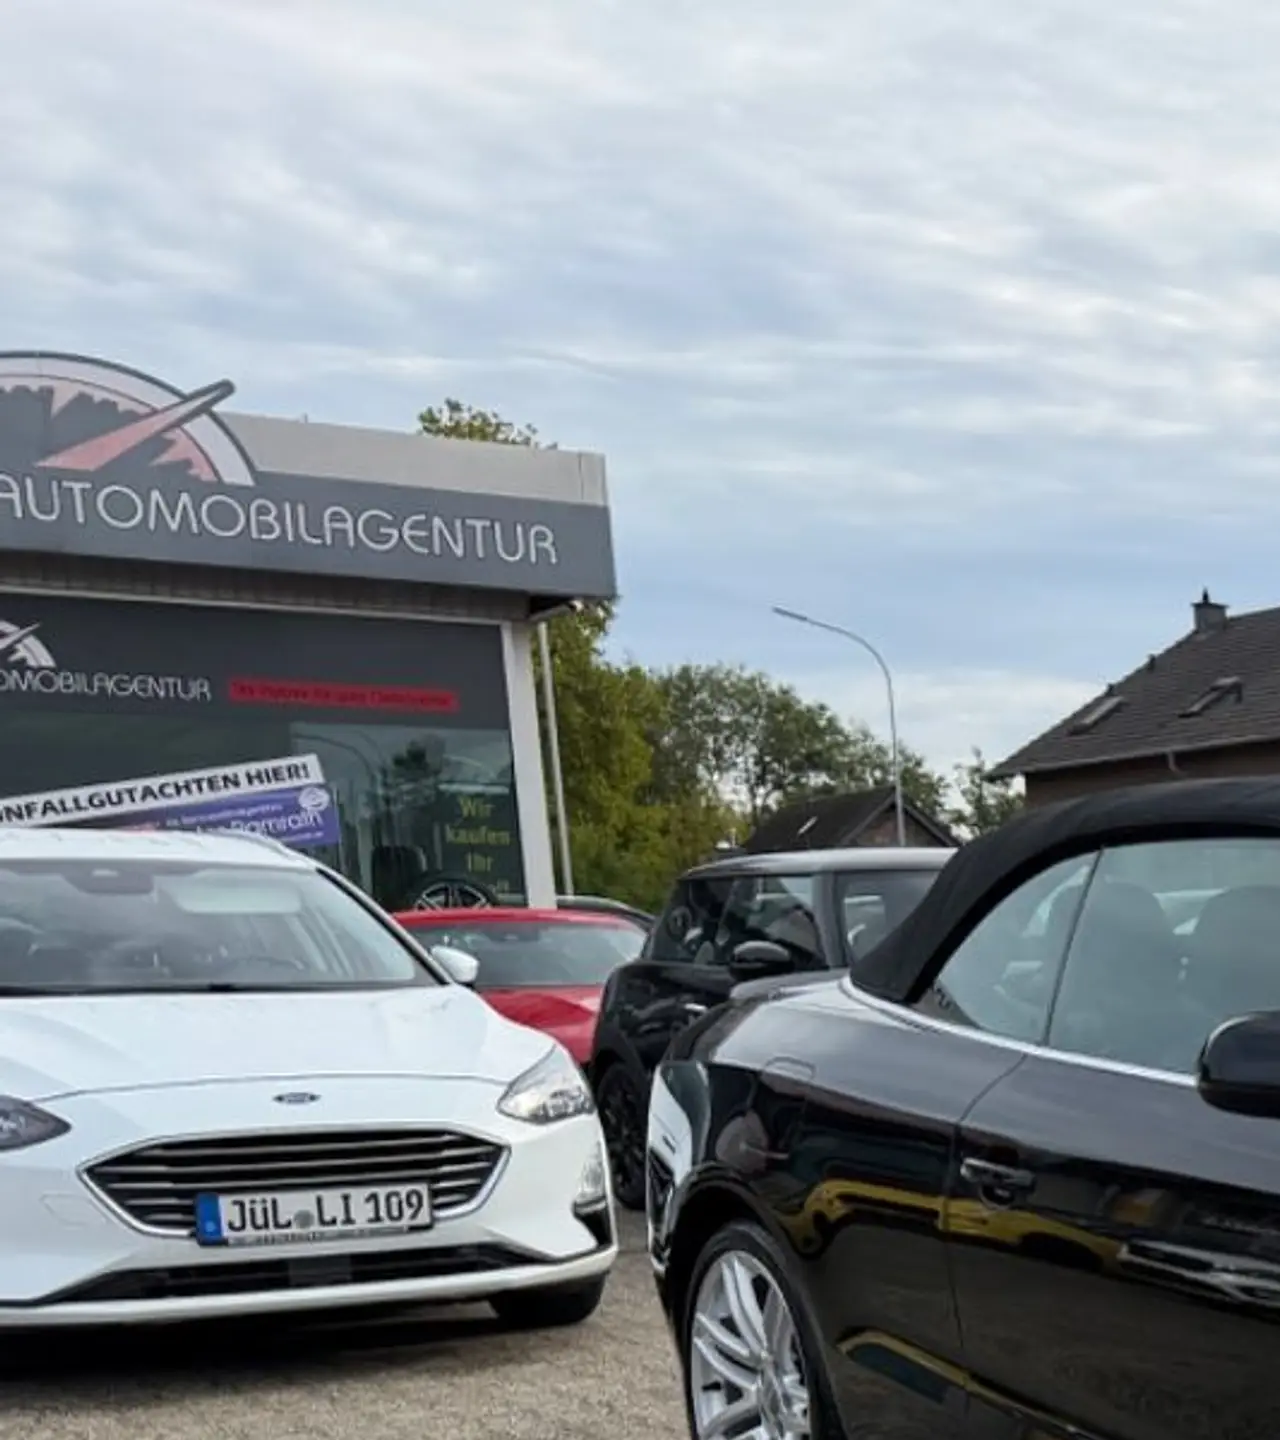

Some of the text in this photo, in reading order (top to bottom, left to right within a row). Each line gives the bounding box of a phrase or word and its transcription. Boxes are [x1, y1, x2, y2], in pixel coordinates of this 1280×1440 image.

[0, 473, 558, 565] AUTOMOBILAGENTUR
[0, 772, 241, 823] NFALLGUTACHTEN
[245, 762, 311, 786] HIER!
[228, 1188, 425, 1232] JÜL LI 109
